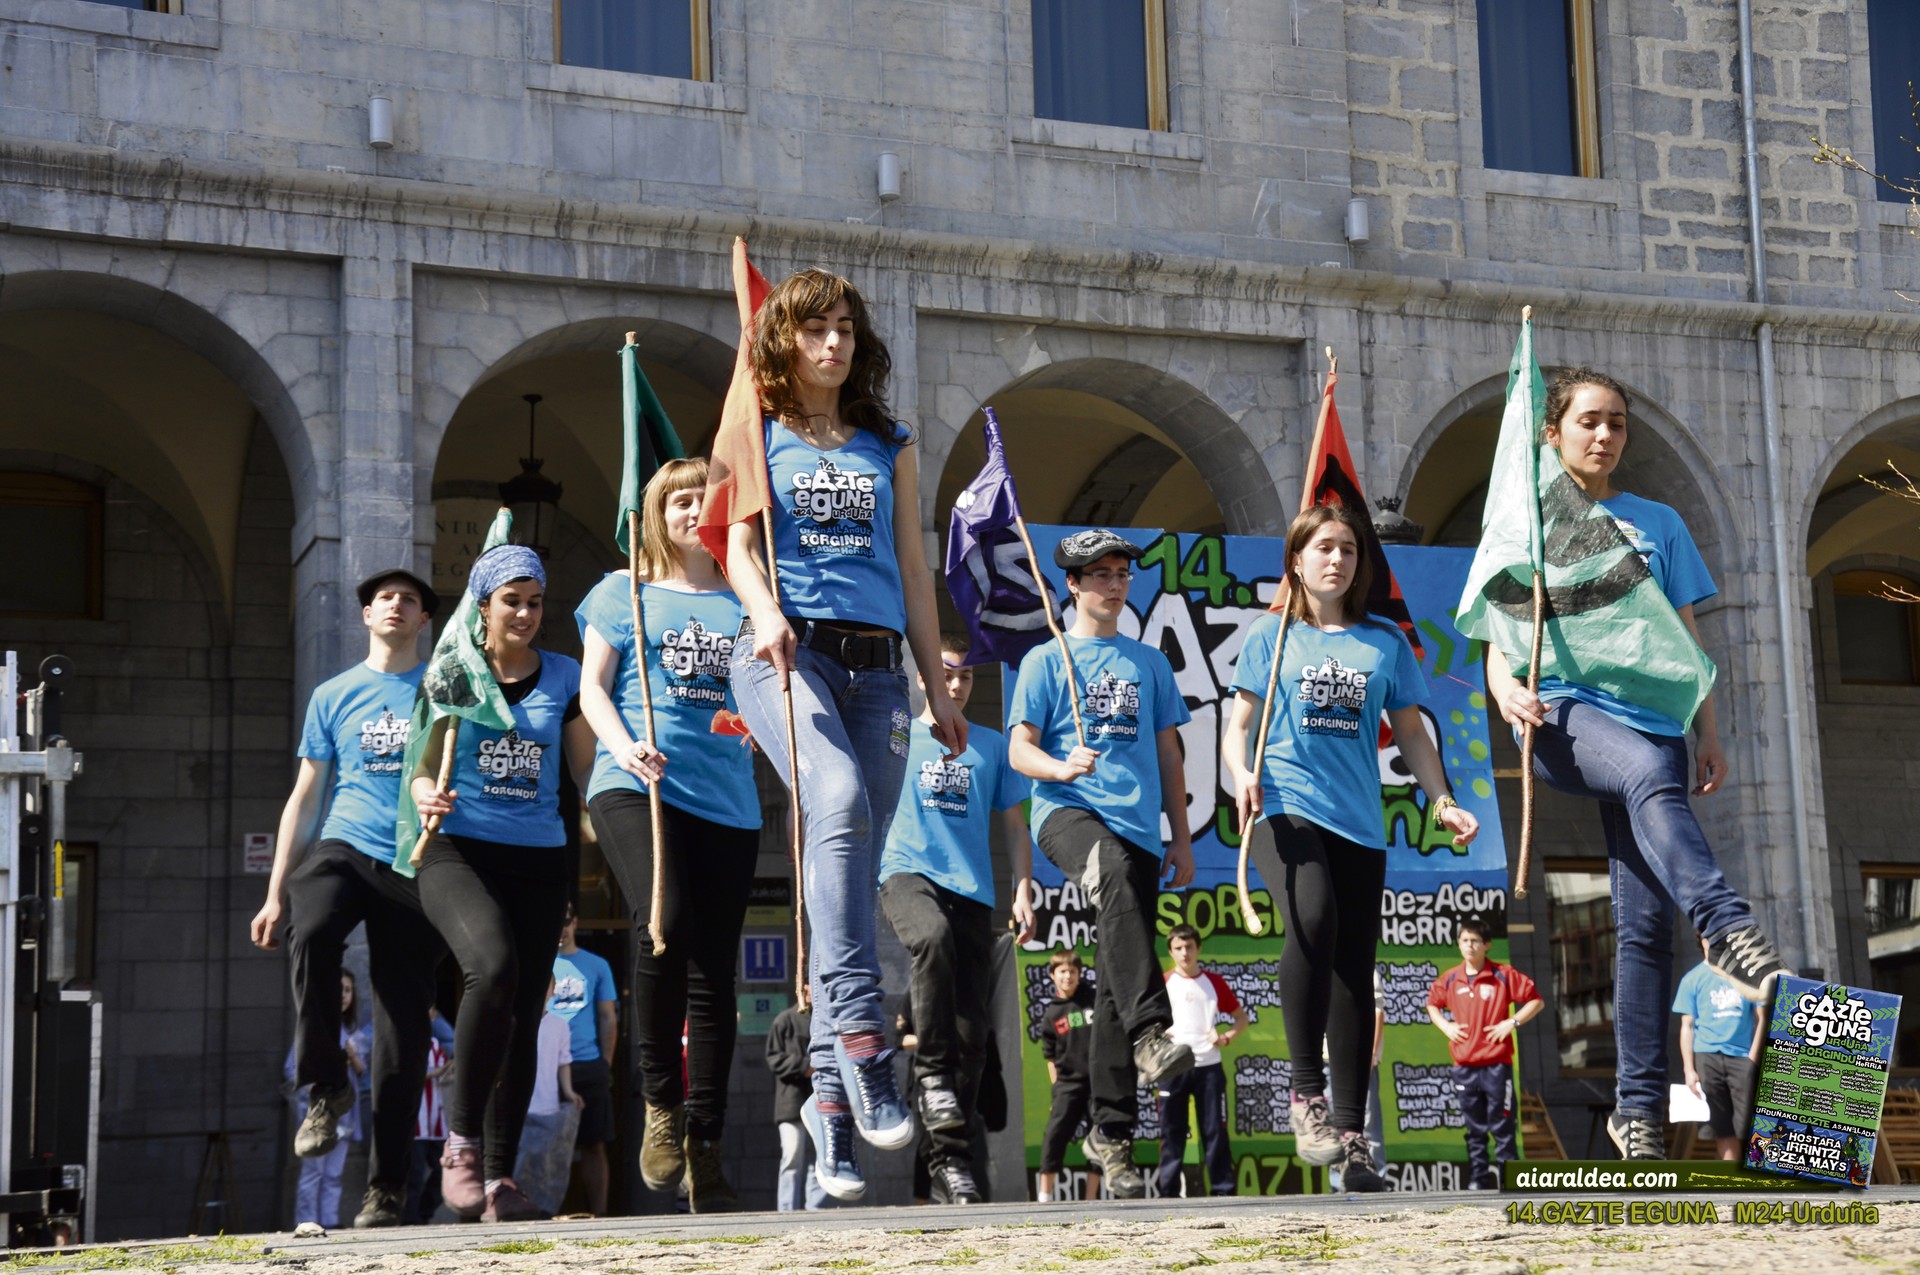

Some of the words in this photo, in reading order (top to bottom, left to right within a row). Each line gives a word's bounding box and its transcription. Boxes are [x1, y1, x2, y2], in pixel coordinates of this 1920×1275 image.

[799, 534, 871, 547] SORGINDU
[665, 685, 726, 702] SORGINDU
[1301, 717, 1359, 731] SORGINDU
